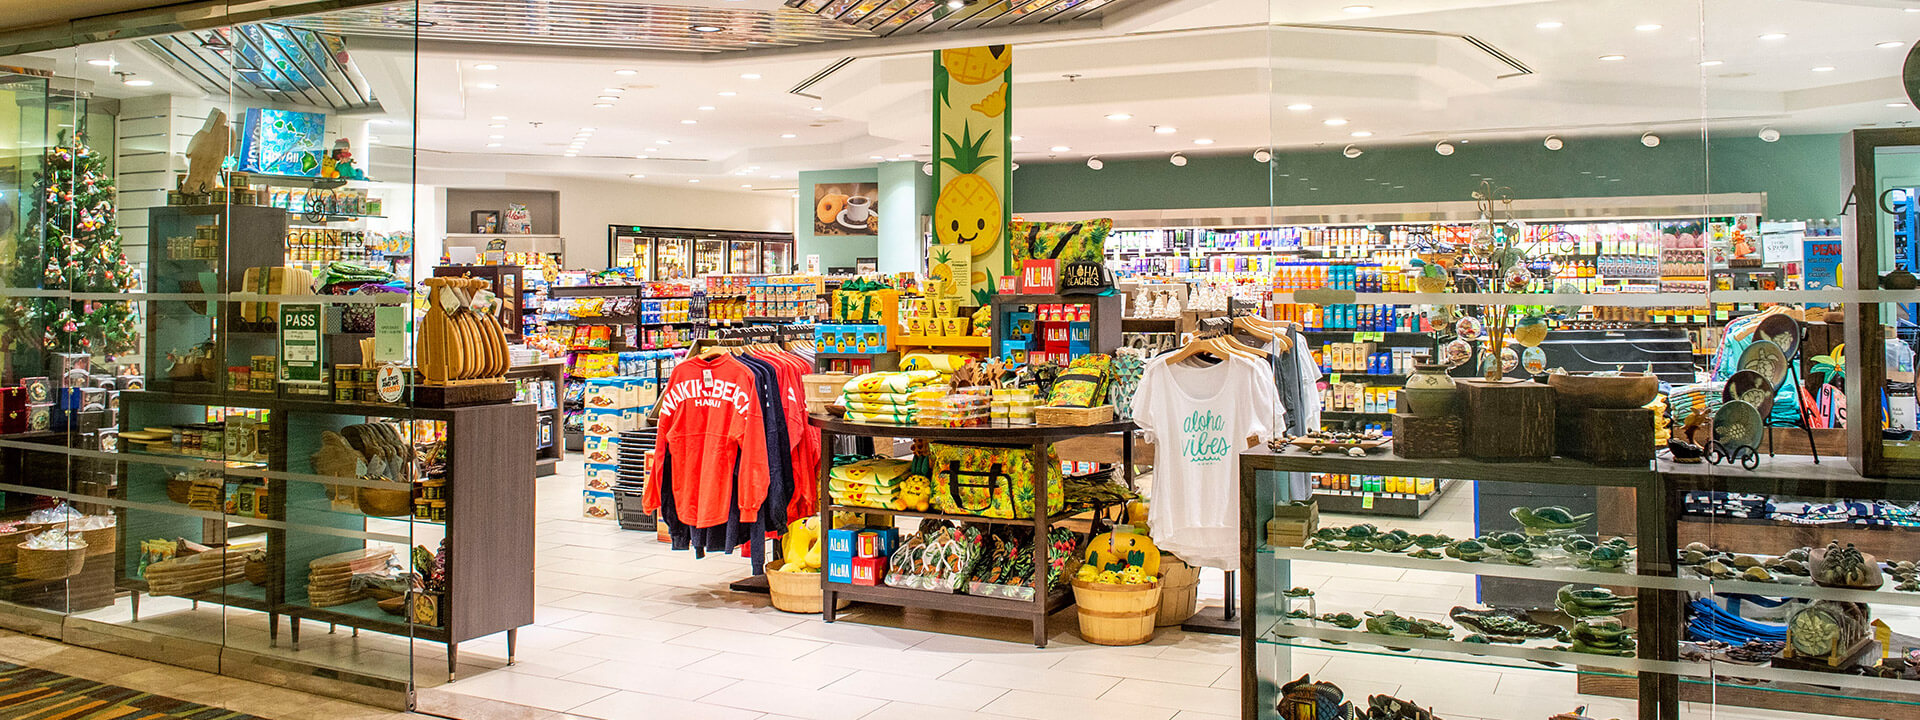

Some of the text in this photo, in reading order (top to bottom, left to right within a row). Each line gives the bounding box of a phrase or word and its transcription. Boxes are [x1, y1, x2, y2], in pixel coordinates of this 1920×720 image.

[1024, 267, 1053, 287] ALOHA
[1067, 264, 1099, 278] ALOHA
[1066, 276, 1099, 287] BEACHES
[285, 314, 316, 327] PASS
[1048, 328, 1068, 341] ALOHA
[660, 379, 711, 416] WAIKIK
[1183, 409, 1225, 433] aloha
[1181, 432, 1231, 457] vibes
[829, 538, 849, 552] ALOHA
[829, 562, 849, 578] ALOHA
[853, 565, 873, 580] ALOHA
